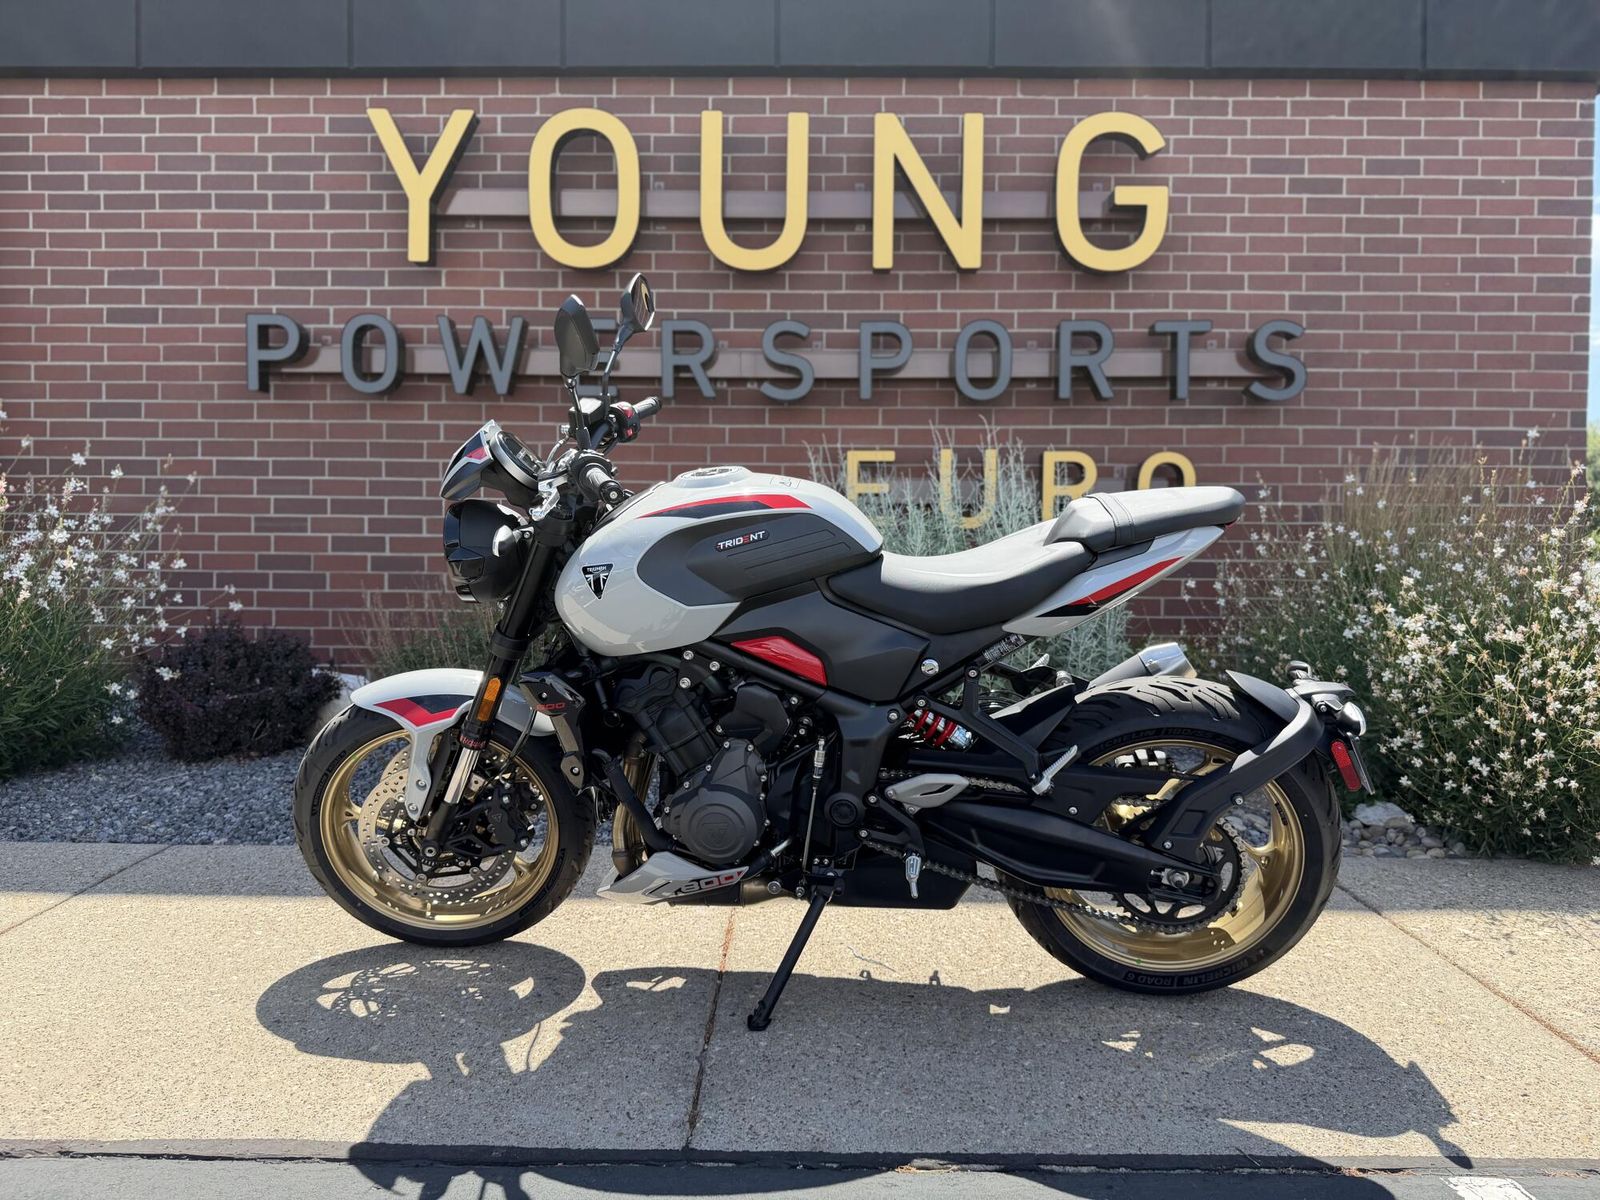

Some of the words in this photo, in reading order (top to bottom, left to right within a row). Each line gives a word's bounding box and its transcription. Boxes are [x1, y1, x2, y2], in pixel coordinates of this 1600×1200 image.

[366, 107, 1169, 271] YOUNG
[717, 530, 766, 550] TRIDENT
[1126, 971, 1137, 981] 6
[1138, 973, 1173, 986] ROAD
[1182, 959, 1250, 986] MICHELIN
